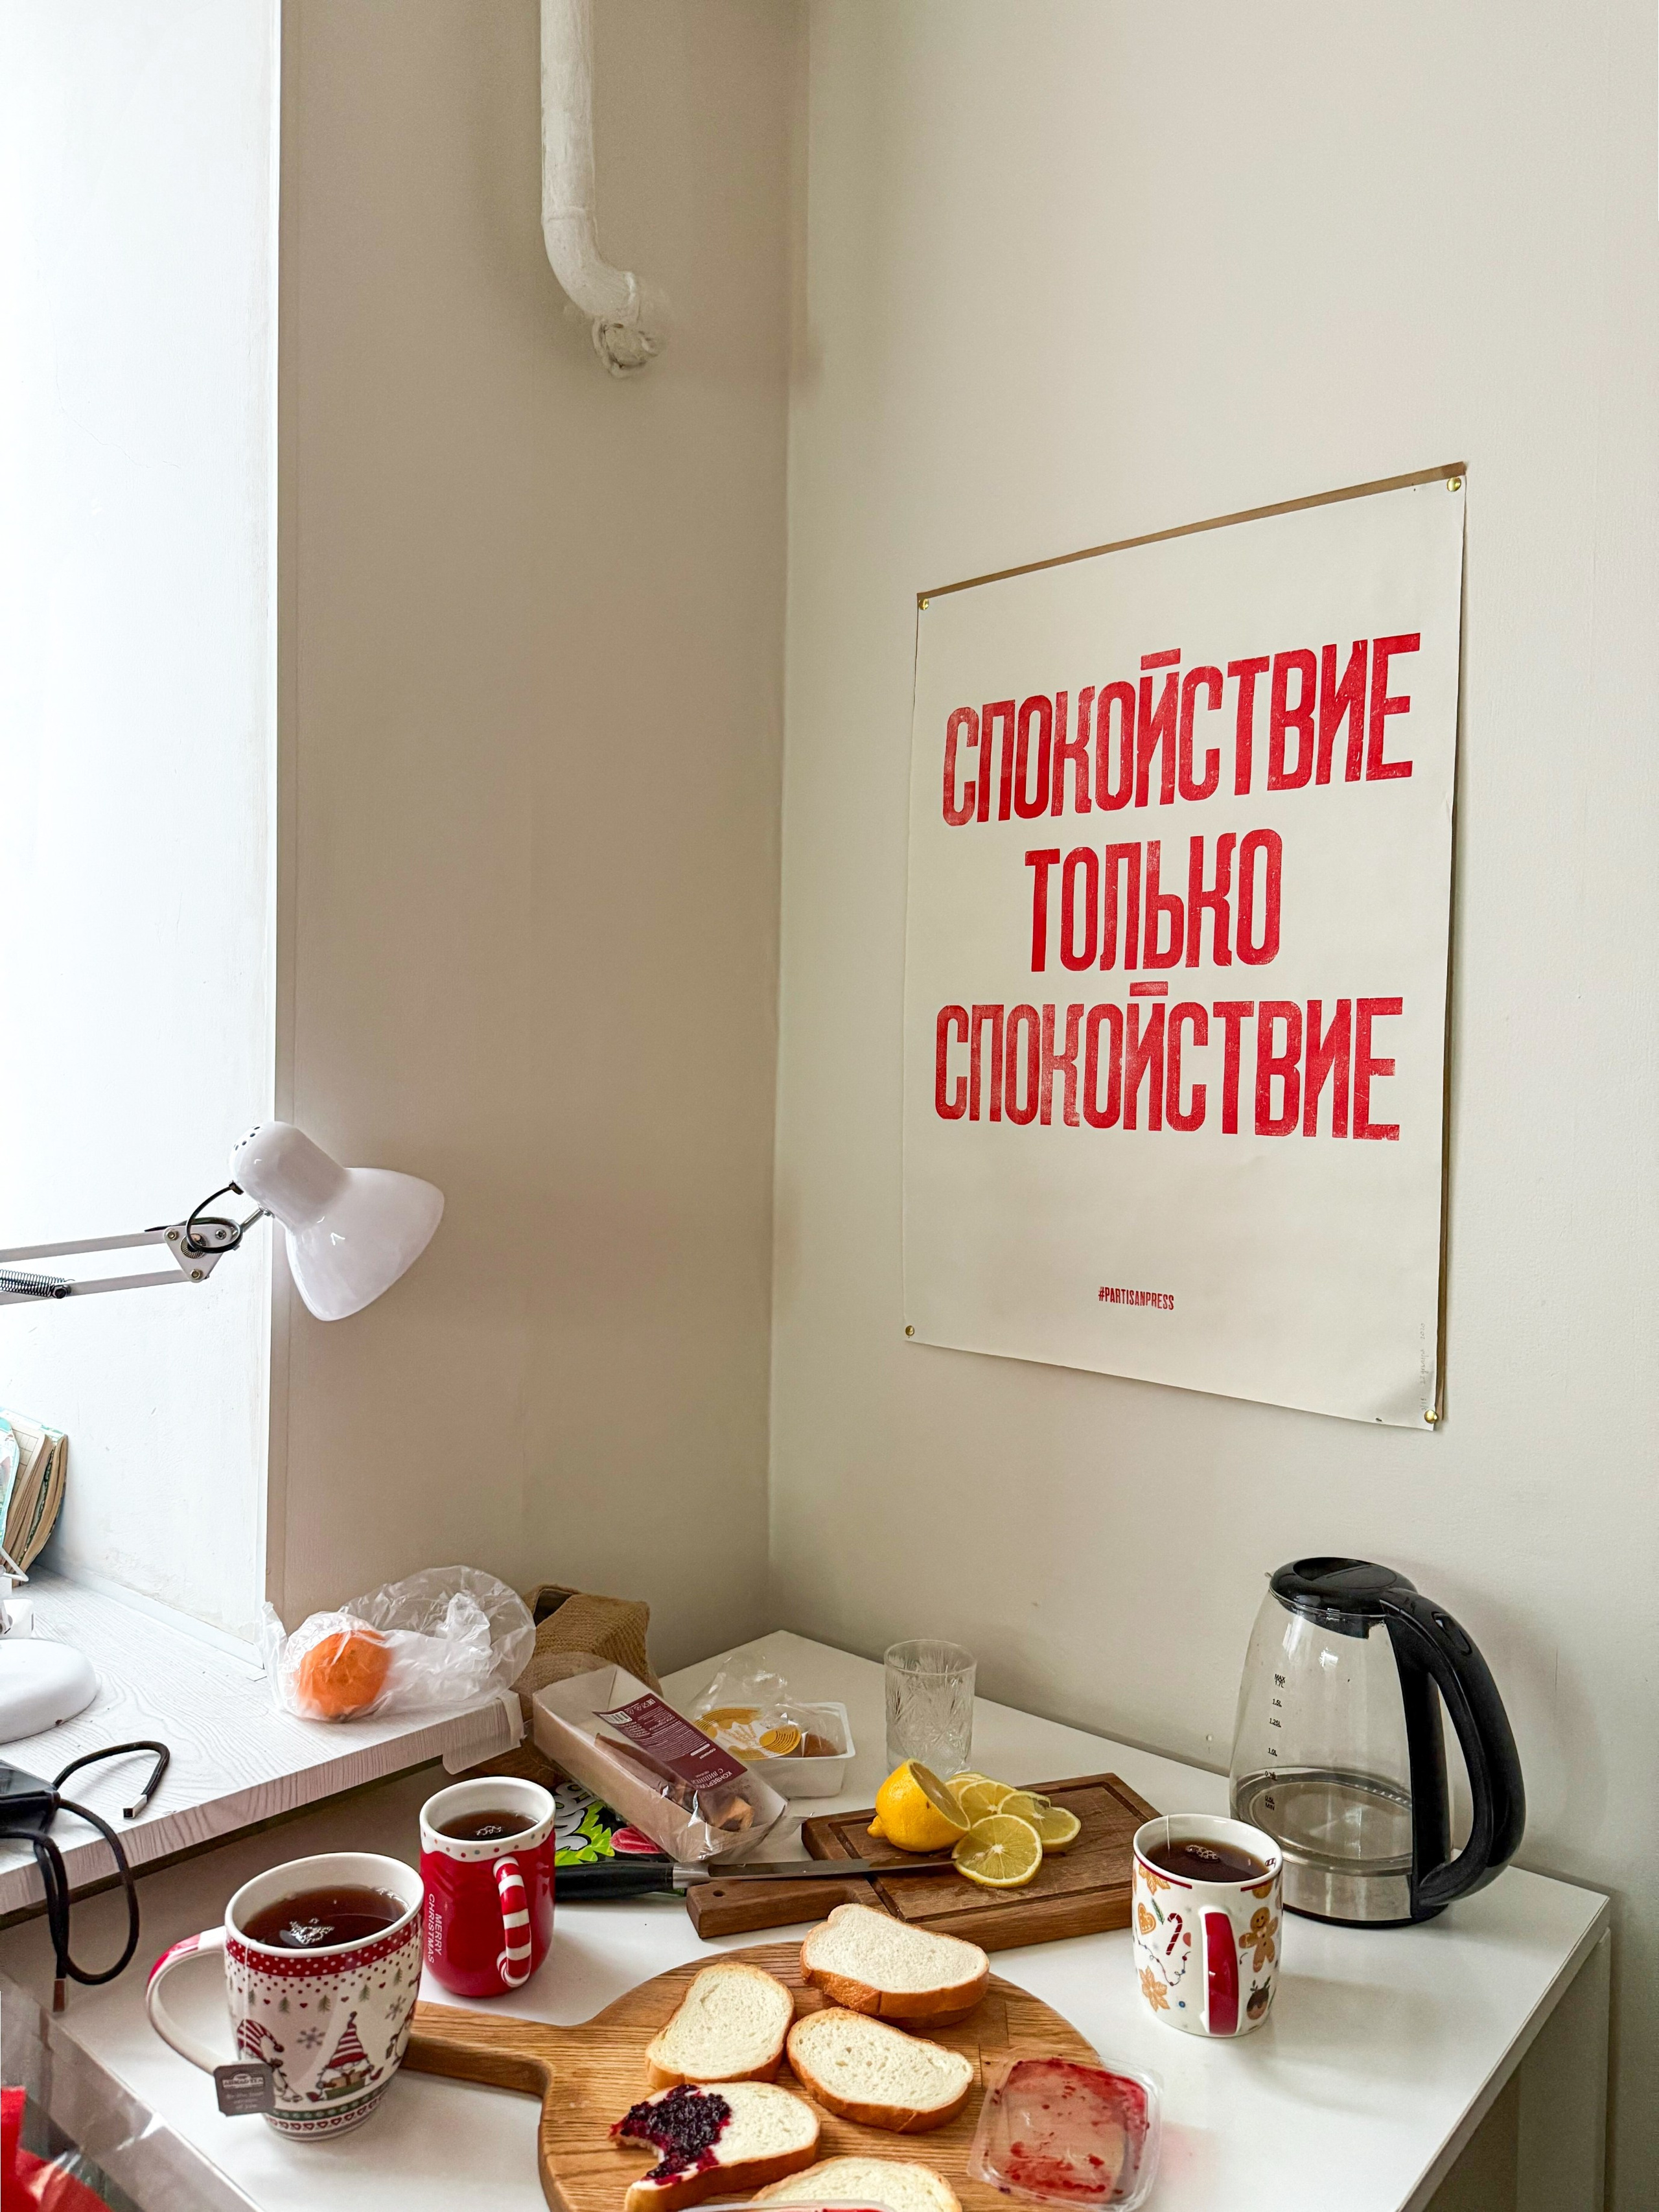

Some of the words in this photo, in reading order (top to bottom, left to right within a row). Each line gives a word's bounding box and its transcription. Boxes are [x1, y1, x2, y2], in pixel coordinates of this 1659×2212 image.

[942, 632, 1421, 827] СПОКОЙСТВИЕ
[1024, 828, 1283, 973] ТОЛЬКО
[934, 981, 1404, 1141] СПОКОЙСТВИЕ
[1098, 1286, 1175, 1310] #PARTISANPRESS
[1274, 1673, 1286, 1683] MAX
[1269, 1717, 1282, 1728] 1.25L
